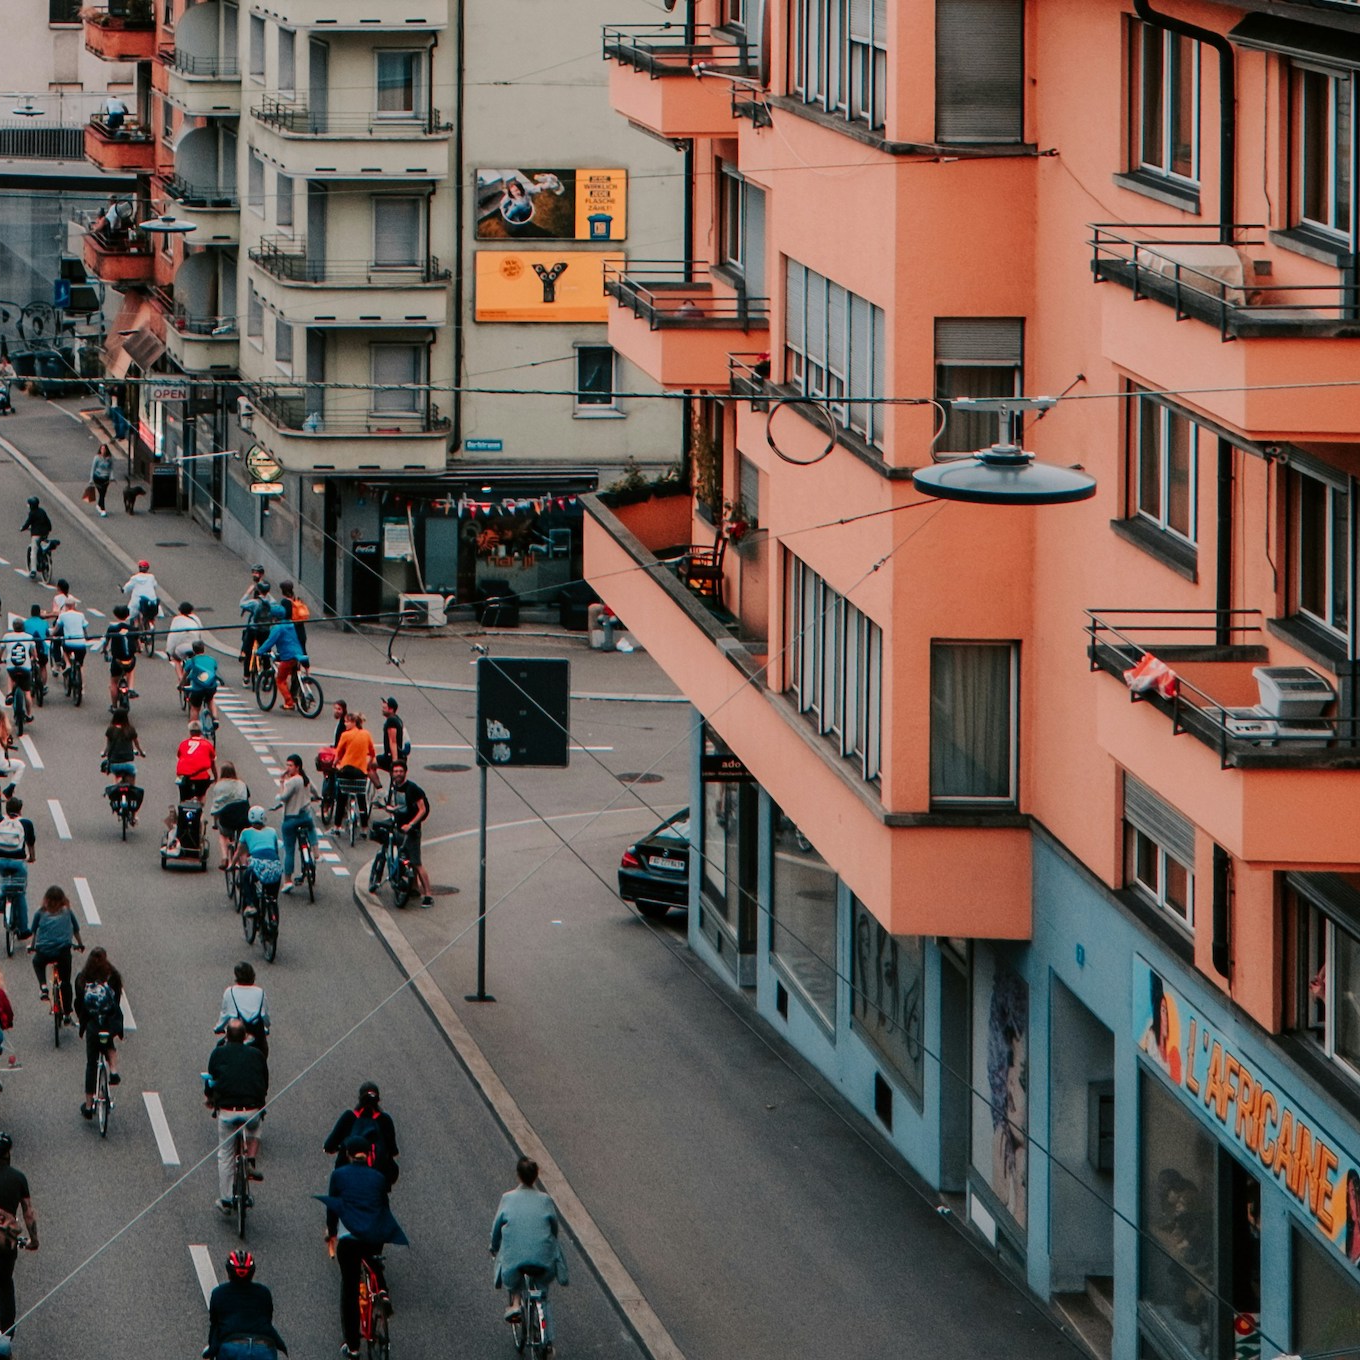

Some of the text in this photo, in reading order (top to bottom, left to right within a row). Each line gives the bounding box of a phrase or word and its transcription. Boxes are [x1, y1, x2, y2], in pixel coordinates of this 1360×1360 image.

[154, 388, 186, 399] OPEN
[187, 740, 200, 755] 7
[1186, 1016, 1338, 1234] L'AFRICAINE
